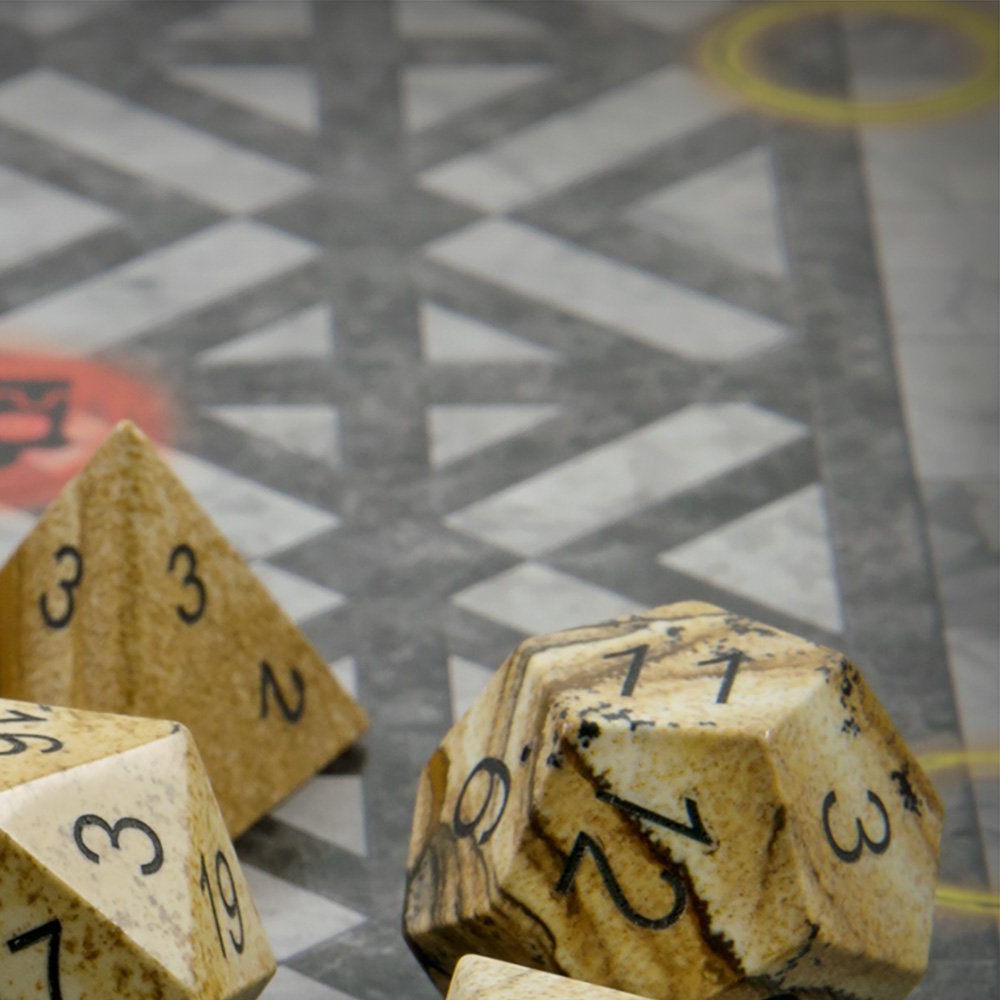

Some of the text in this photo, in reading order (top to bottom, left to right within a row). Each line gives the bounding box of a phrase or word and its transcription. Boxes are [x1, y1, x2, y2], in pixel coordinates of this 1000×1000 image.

[39, 545, 83, 630] 3
[167, 544, 209, 625] 3
[259, 659, 305, 724] 2
[73, 812, 164, 876] 3
[556, 790, 717, 931] 12
[821, 789, 891, 864] 3
[199, 849, 245, 959] 19
